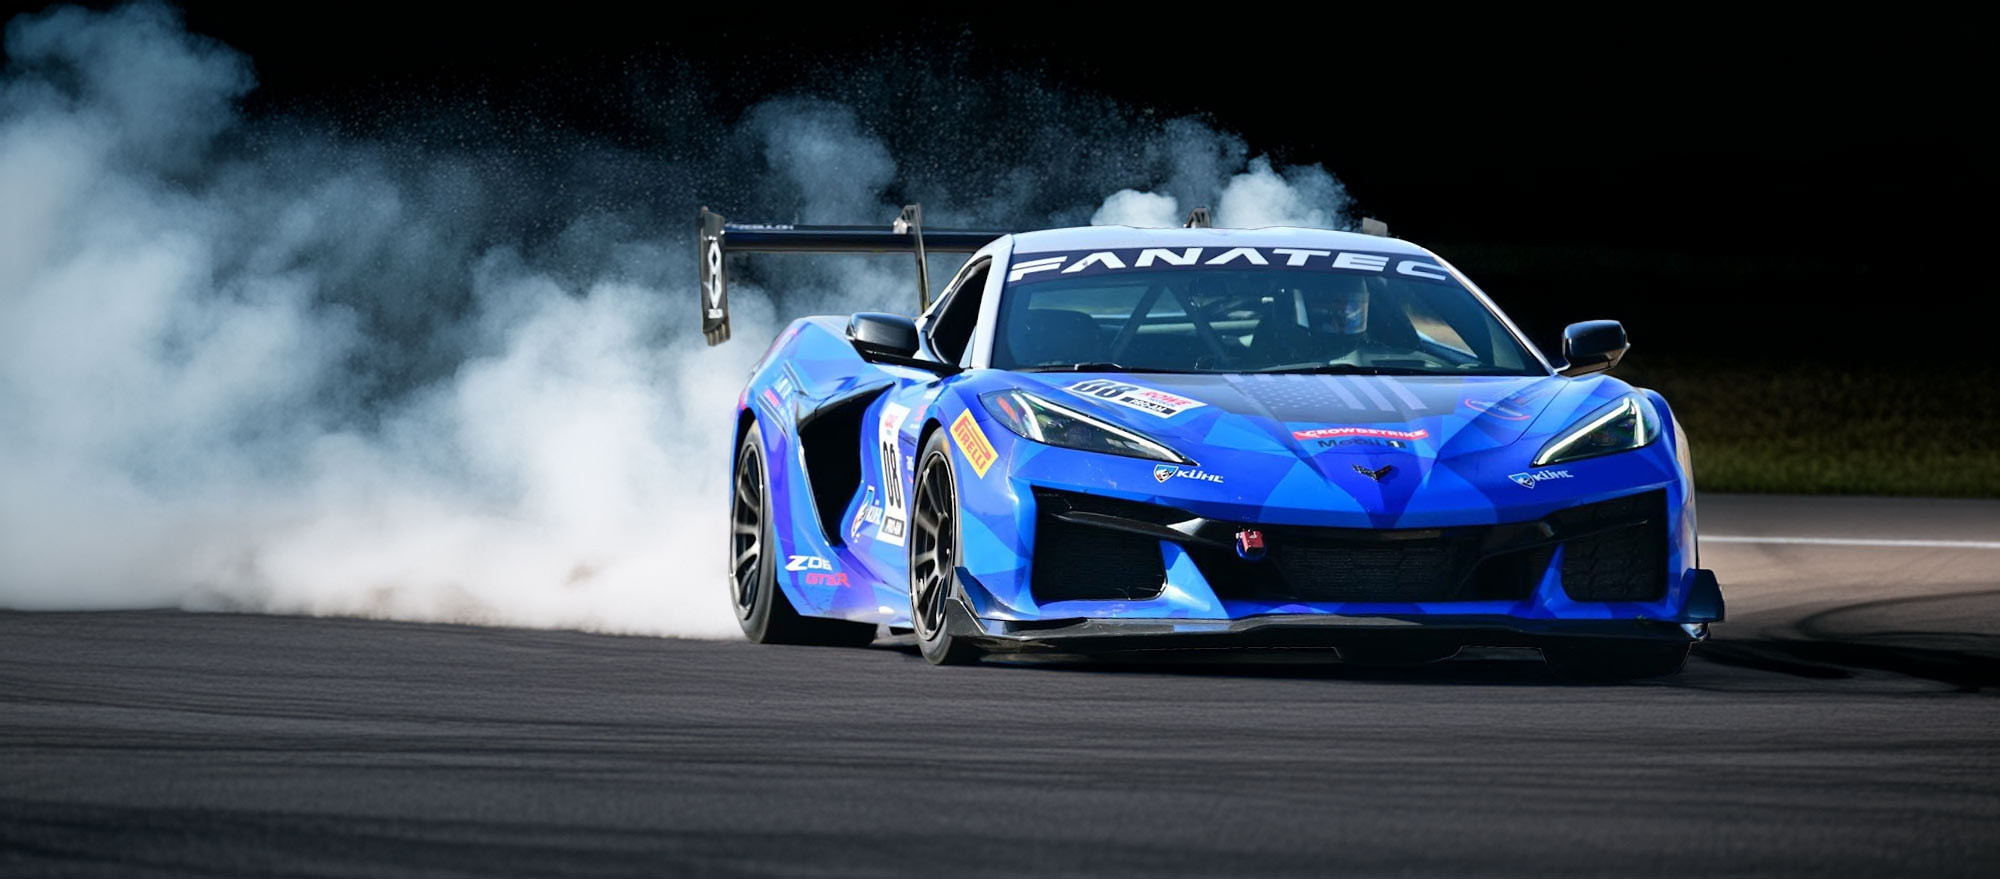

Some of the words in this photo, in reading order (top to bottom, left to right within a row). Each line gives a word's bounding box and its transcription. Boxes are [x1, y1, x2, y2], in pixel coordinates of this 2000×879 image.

[1009, 247, 1448, 282] FANATEC
[1072, 381, 1139, 398] 08
[953, 415, 992, 471] PIRELLI
[1305, 427, 1426, 438] CROWDSTRIKE
[1317, 439, 1382, 448] Mobil
[883, 441, 902, 509] 08
